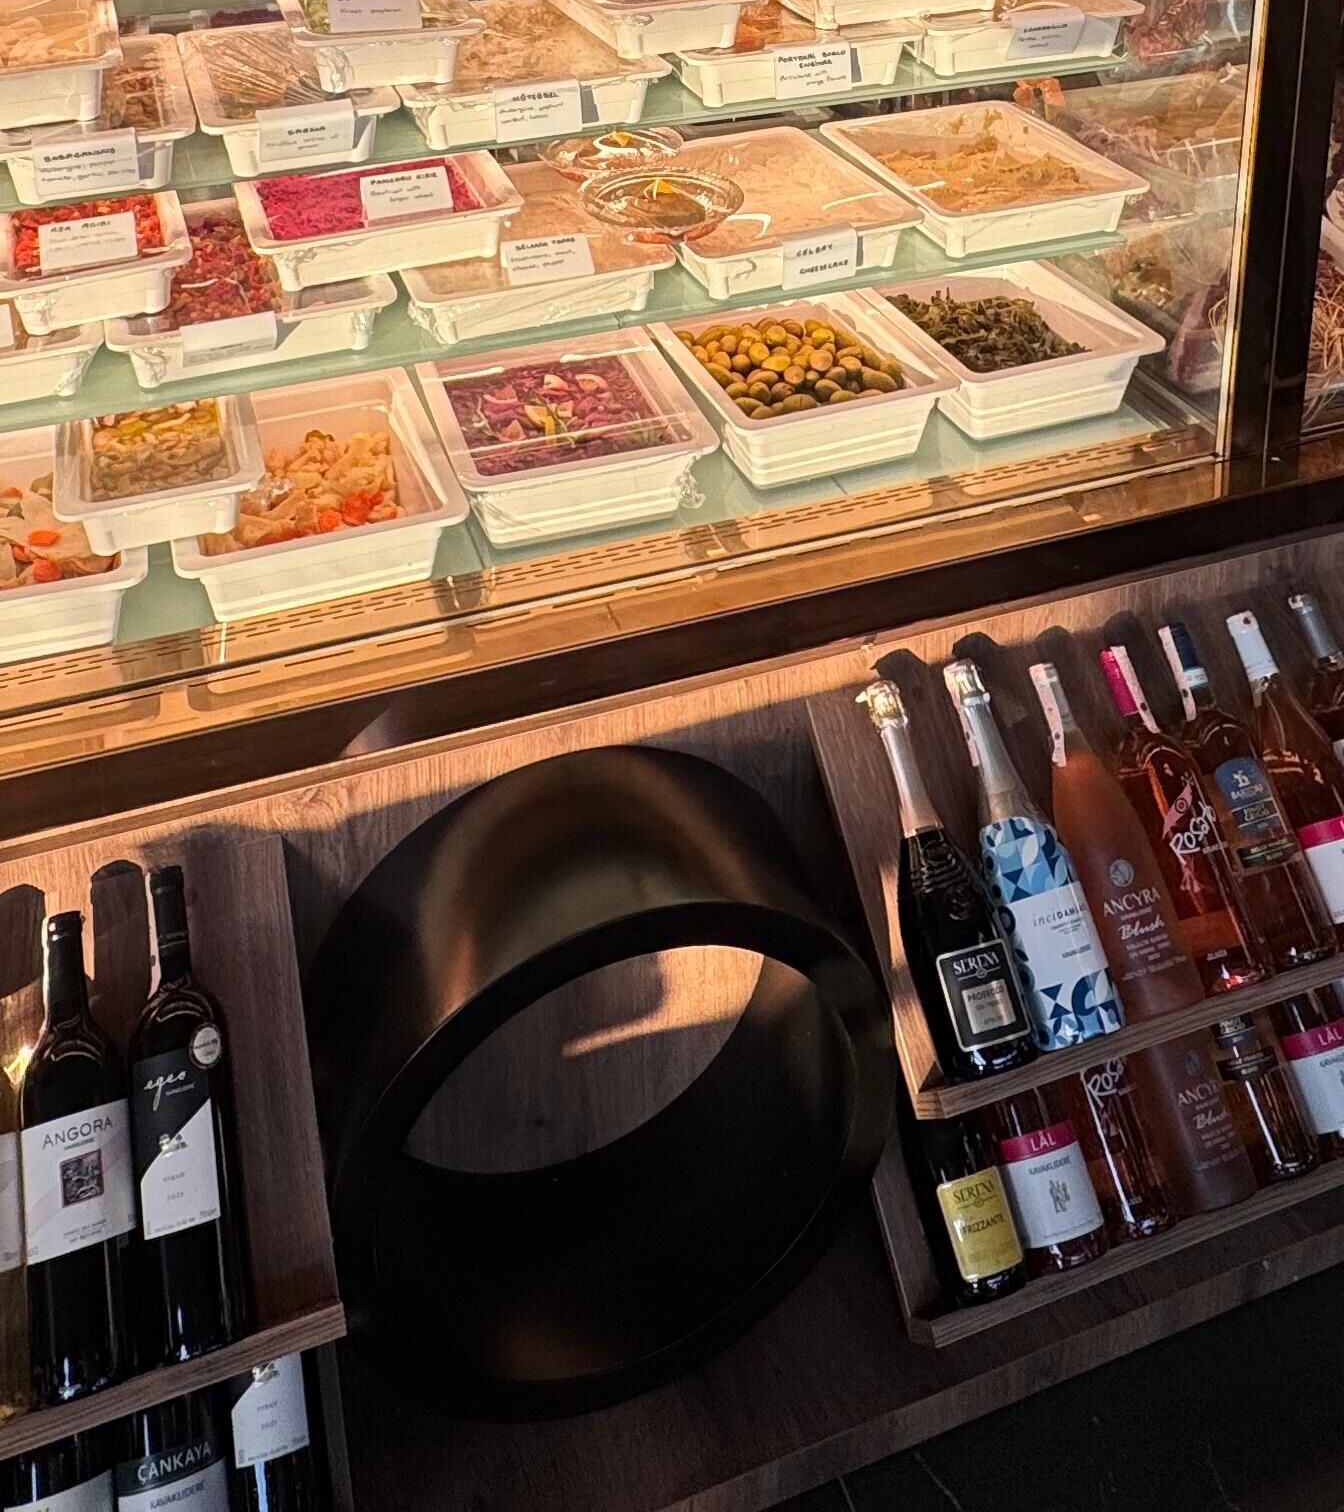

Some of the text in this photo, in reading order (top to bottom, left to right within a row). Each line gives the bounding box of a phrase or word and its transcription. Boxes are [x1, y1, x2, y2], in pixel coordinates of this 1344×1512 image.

[1103, 887, 1161, 918] ANCYRA
[1117, 913, 1166, 941] Blush
[953, 949, 1000, 977] SERENA
[42, 1115, 114, 1150] ANGORA
[952, 1179, 996, 1205] SERENA
[962, 1213, 1006, 1235] FRIZZANTE
[136, 1440, 213, 1486] ÇANKAYA
